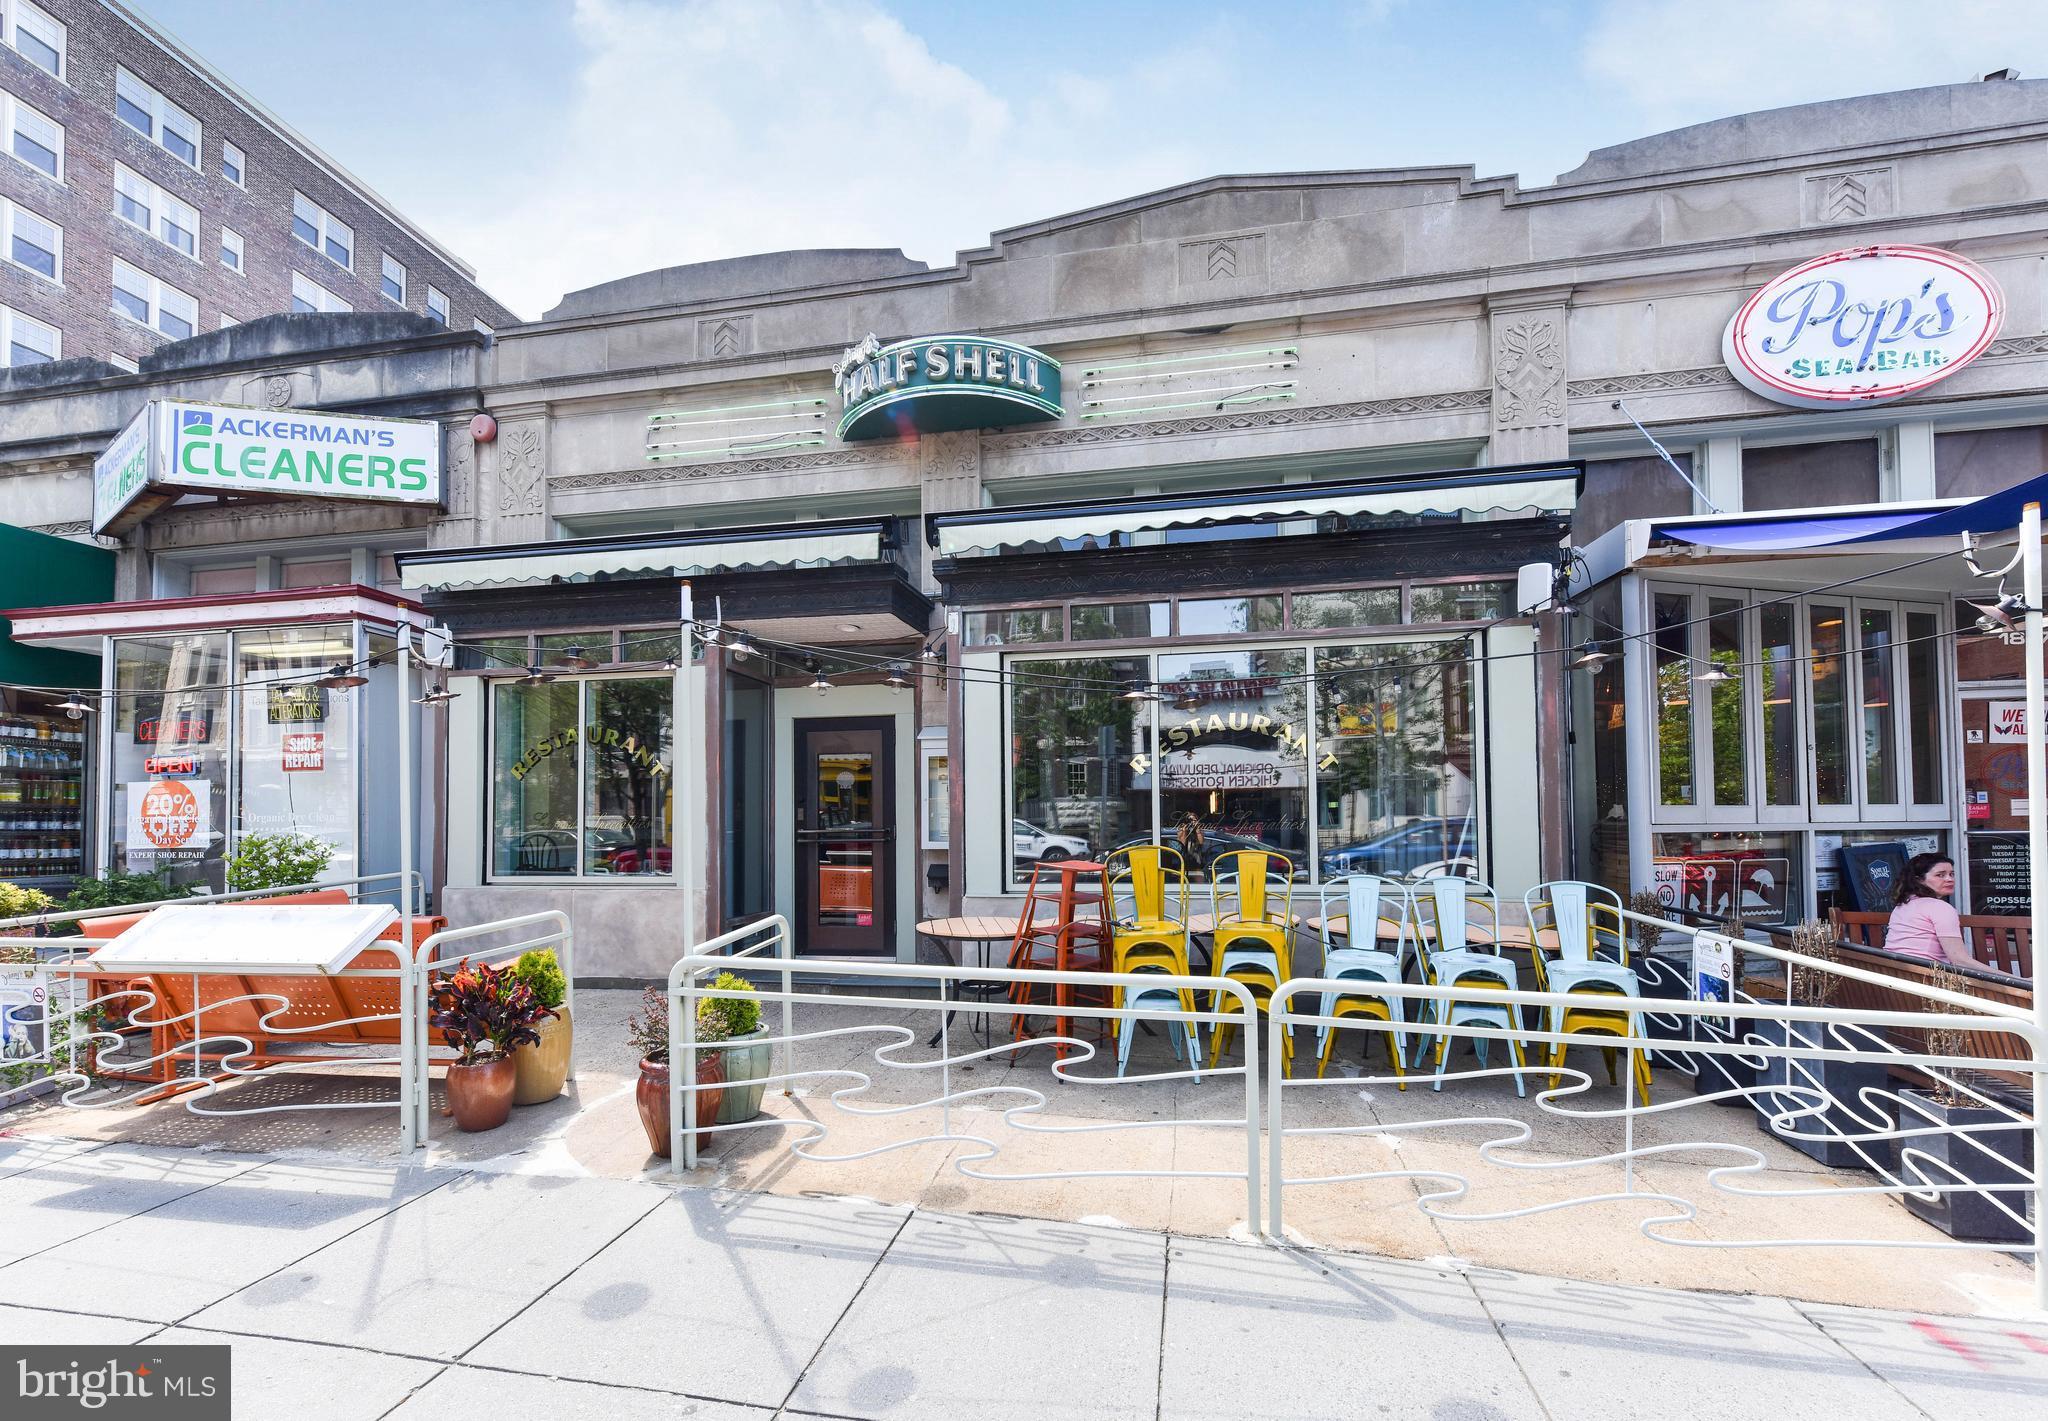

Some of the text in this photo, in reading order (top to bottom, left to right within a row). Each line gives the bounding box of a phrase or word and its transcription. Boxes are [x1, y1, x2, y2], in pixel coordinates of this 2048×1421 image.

[1761, 277, 1970, 372] Pop's
[1790, 349, 1946, 379] SEA BAR
[842, 345, 1045, 409] HALF SHELL
[218, 417, 395, 448] ACKERMAN'S
[182, 441, 428, 491] CLEANERS
[270, 703, 321, 720] ALTERATIONS
[289, 737, 317, 752] SHOE
[1129, 712, 1340, 777] RESTAURANT
[285, 753, 321, 768] REPAIR
[510, 726, 665, 781] RESTAURANT
[144, 758, 194, 773] OPEN
[146, 793, 194, 816] 20%
[149, 815, 190, 836] OFF
[156, 835, 173, 847] Day
[128, 851, 205, 859] EXPERT SHOE REPAIR
[1655, 869, 1678, 882] SLOW
[1870, 866, 1891, 875] SAMUEL
[1873, 872, 1891, 880] ADAMS
[1660, 890, 1671, 902] NO
